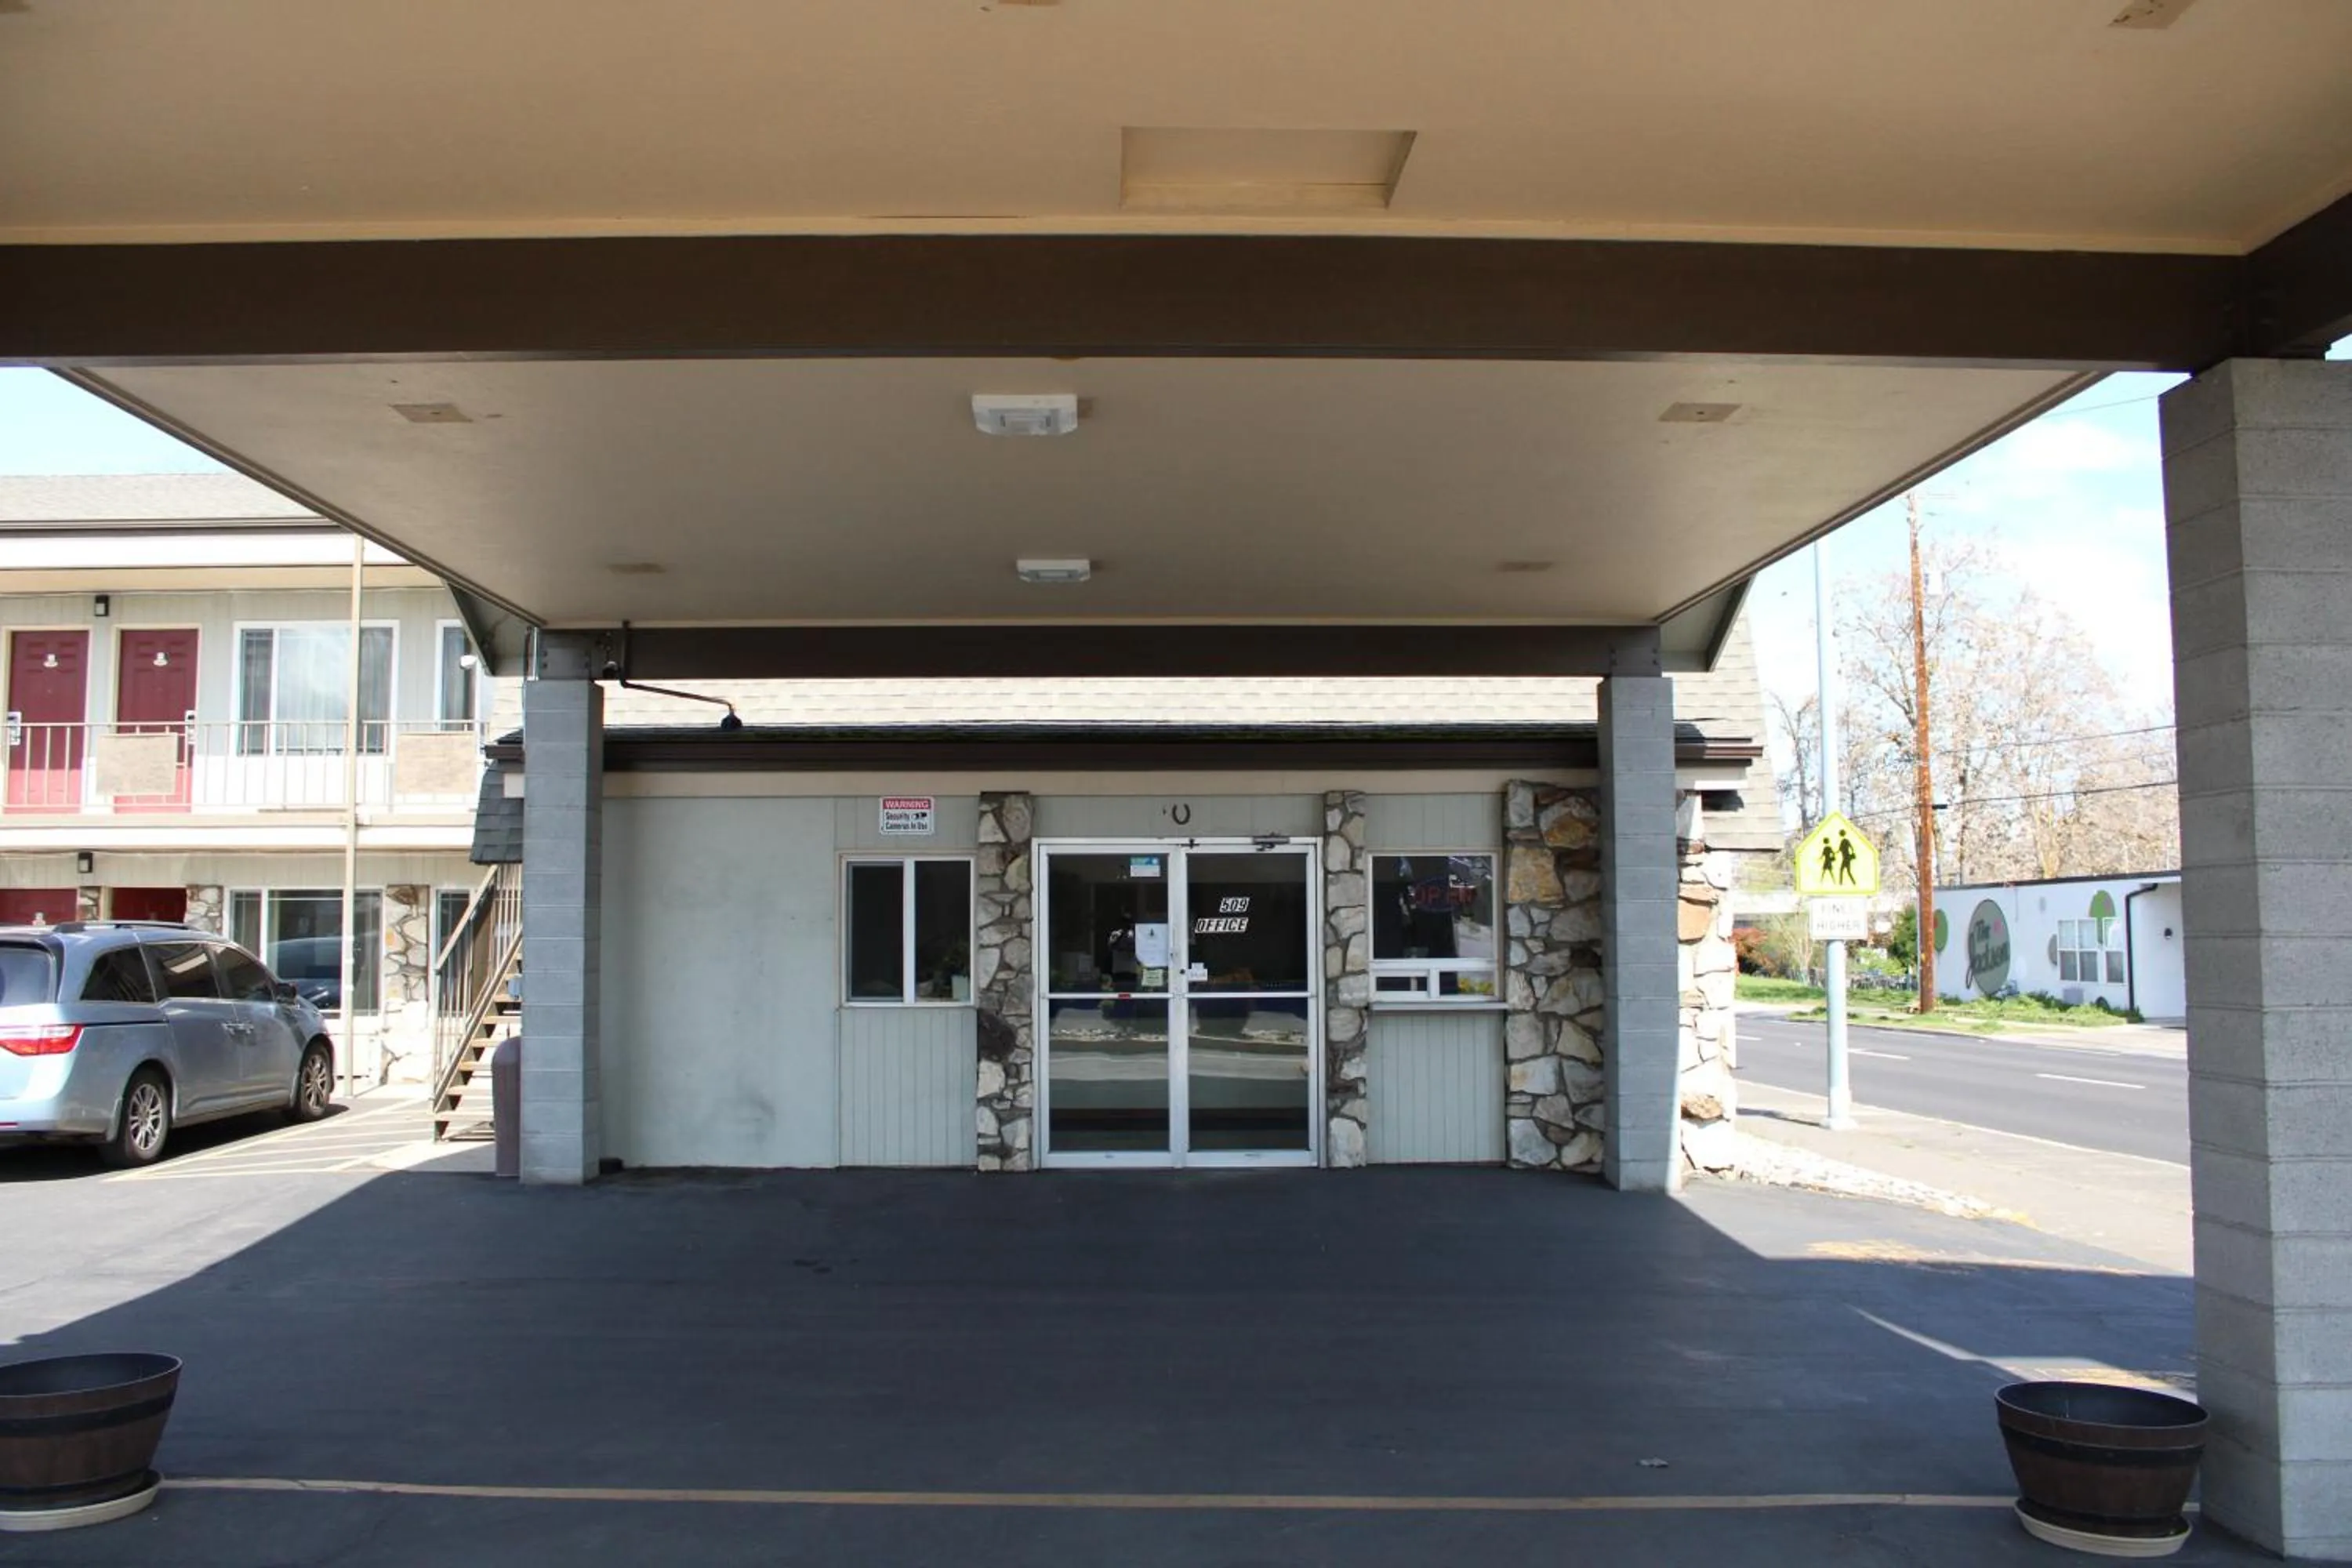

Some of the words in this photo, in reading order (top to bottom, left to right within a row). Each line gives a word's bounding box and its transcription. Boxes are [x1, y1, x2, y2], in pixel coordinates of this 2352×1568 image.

[885, 811, 909, 820] Security
[1220, 898, 1249, 912] 509
[1196, 918, 1247, 932] OFFICE
